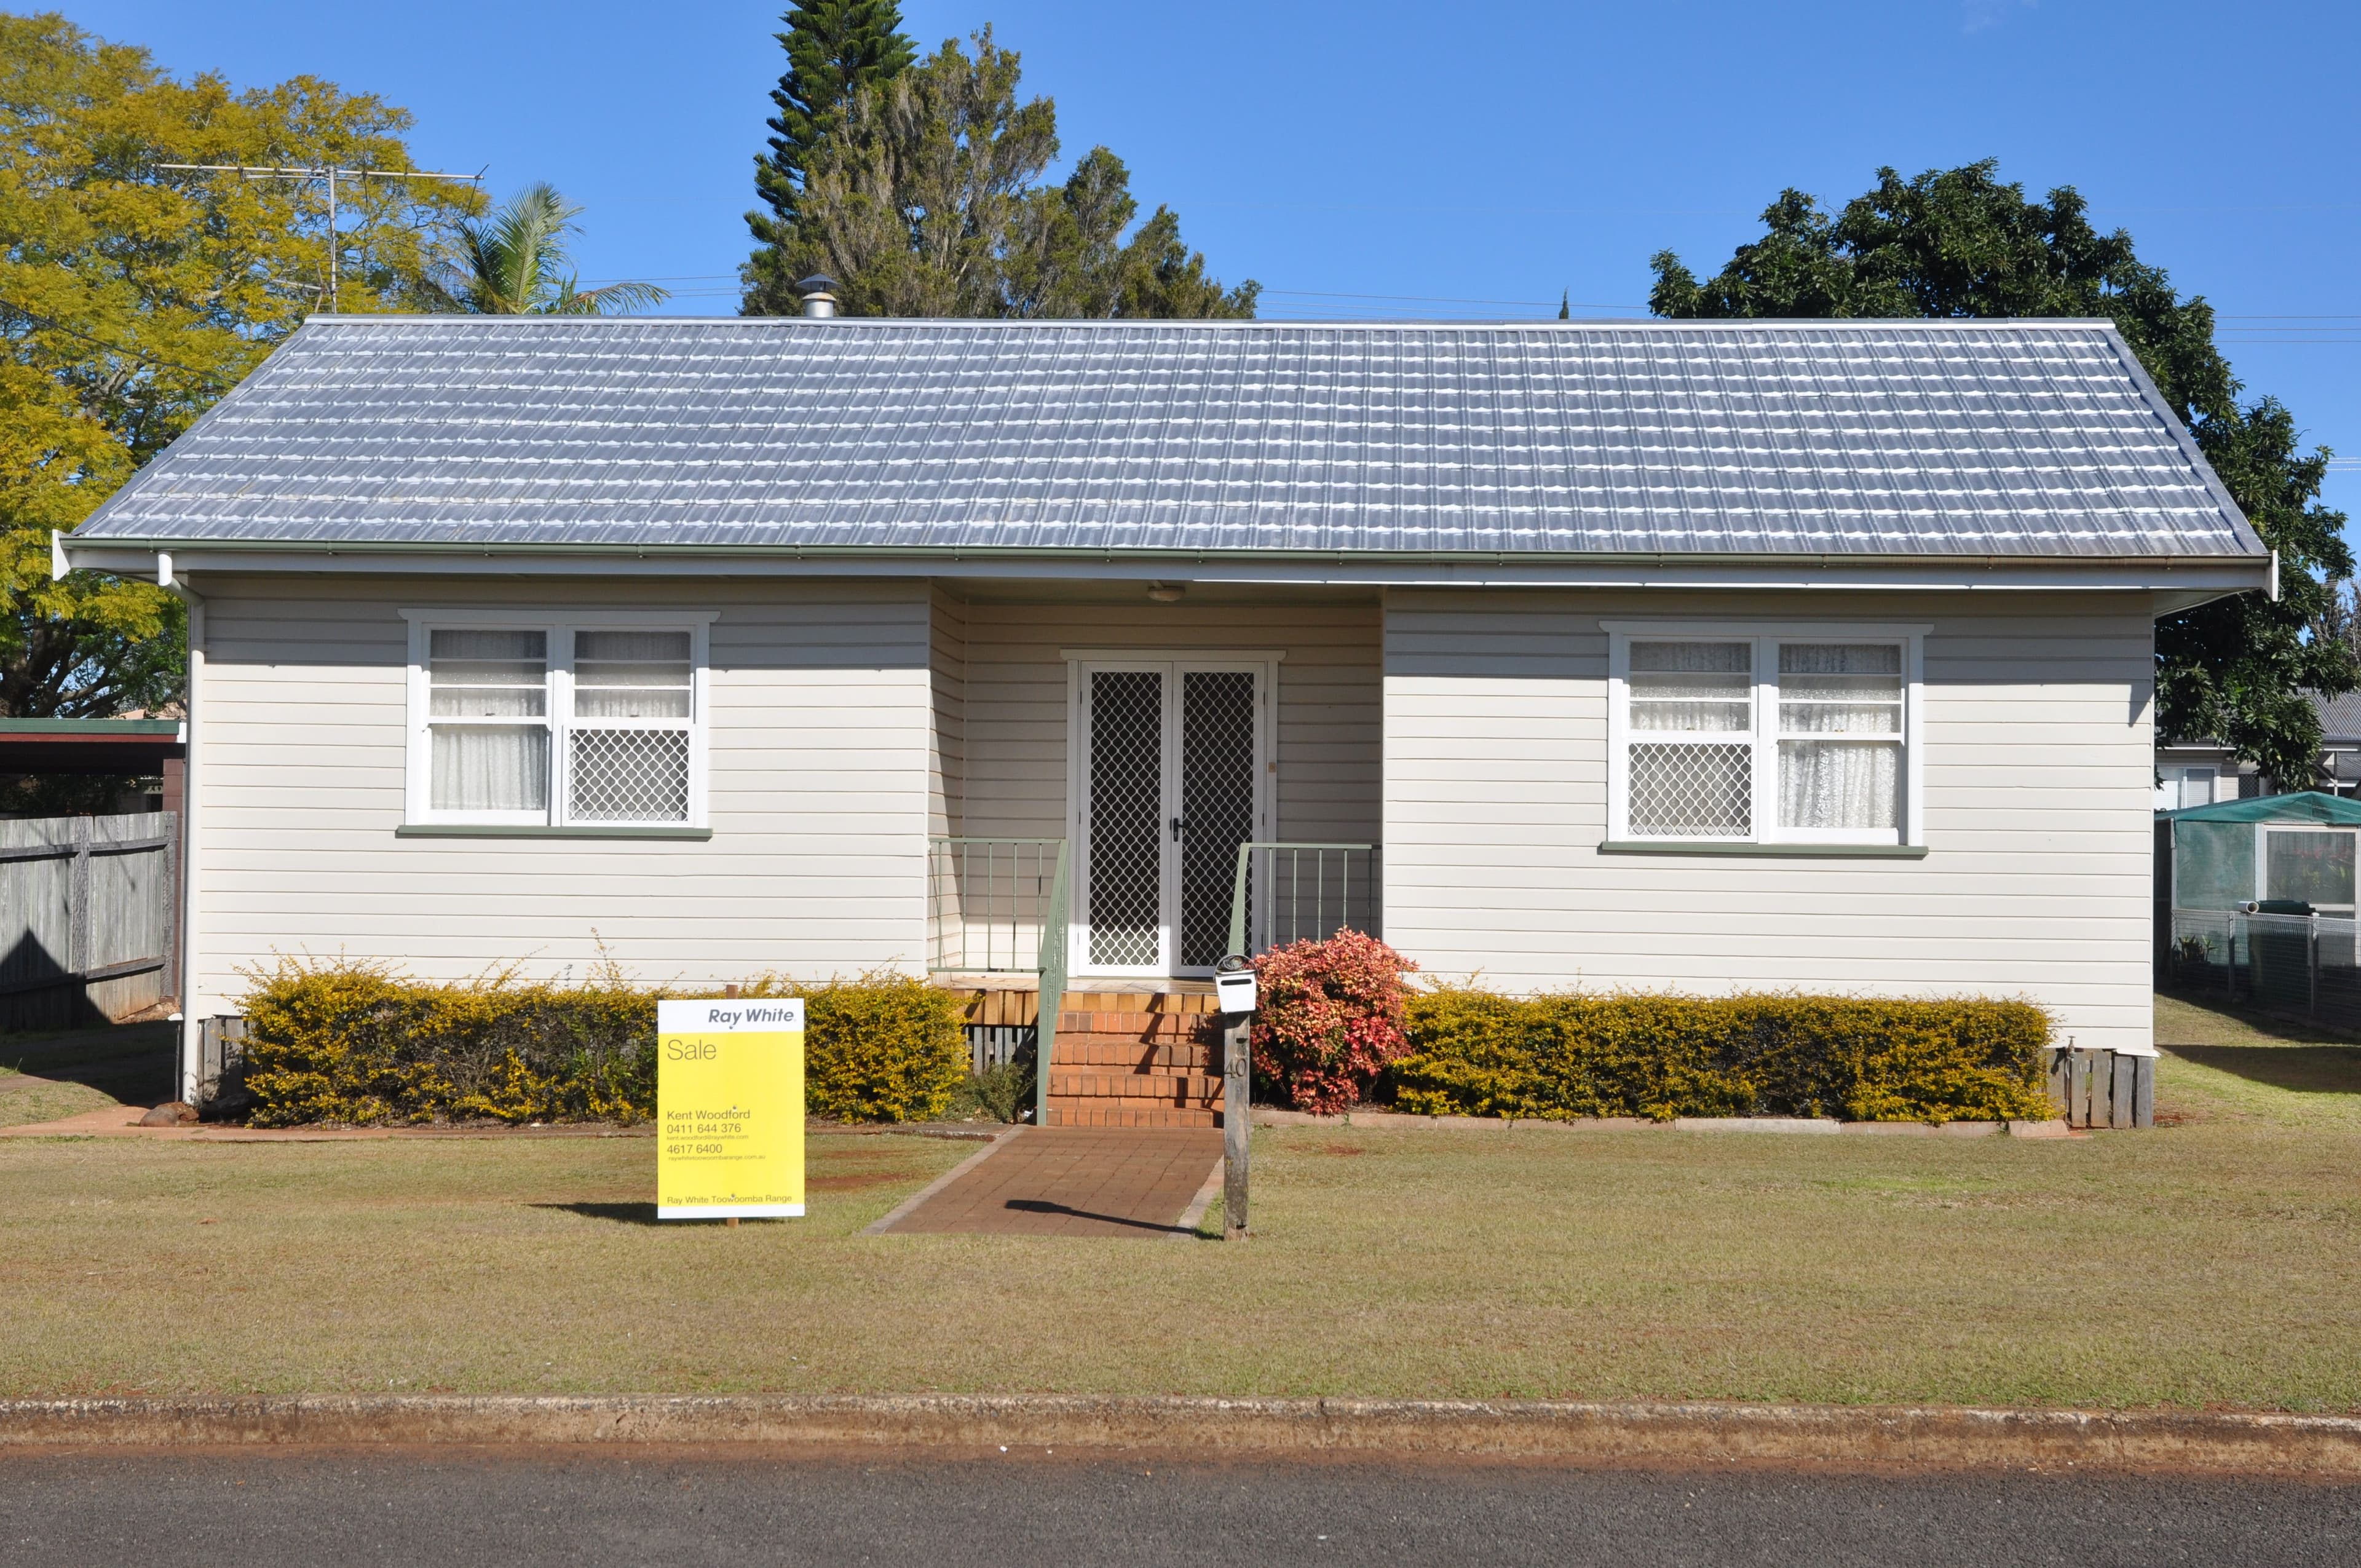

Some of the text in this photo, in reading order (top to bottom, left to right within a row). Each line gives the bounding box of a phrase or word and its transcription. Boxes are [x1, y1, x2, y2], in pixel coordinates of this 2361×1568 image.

[708, 1008, 794, 1025] Ray White
[667, 1039, 716, 1060] Sale
[667, 1109, 750, 1120] Kent Woodford
[667, 1123, 742, 1134] 0411 644 376
[667, 1144, 722, 1154] 4617 6400
[667, 1197, 682, 1205] Ray
[711, 1195, 763, 1203] Toowoomba
[765, 1194, 792, 1203] Range
